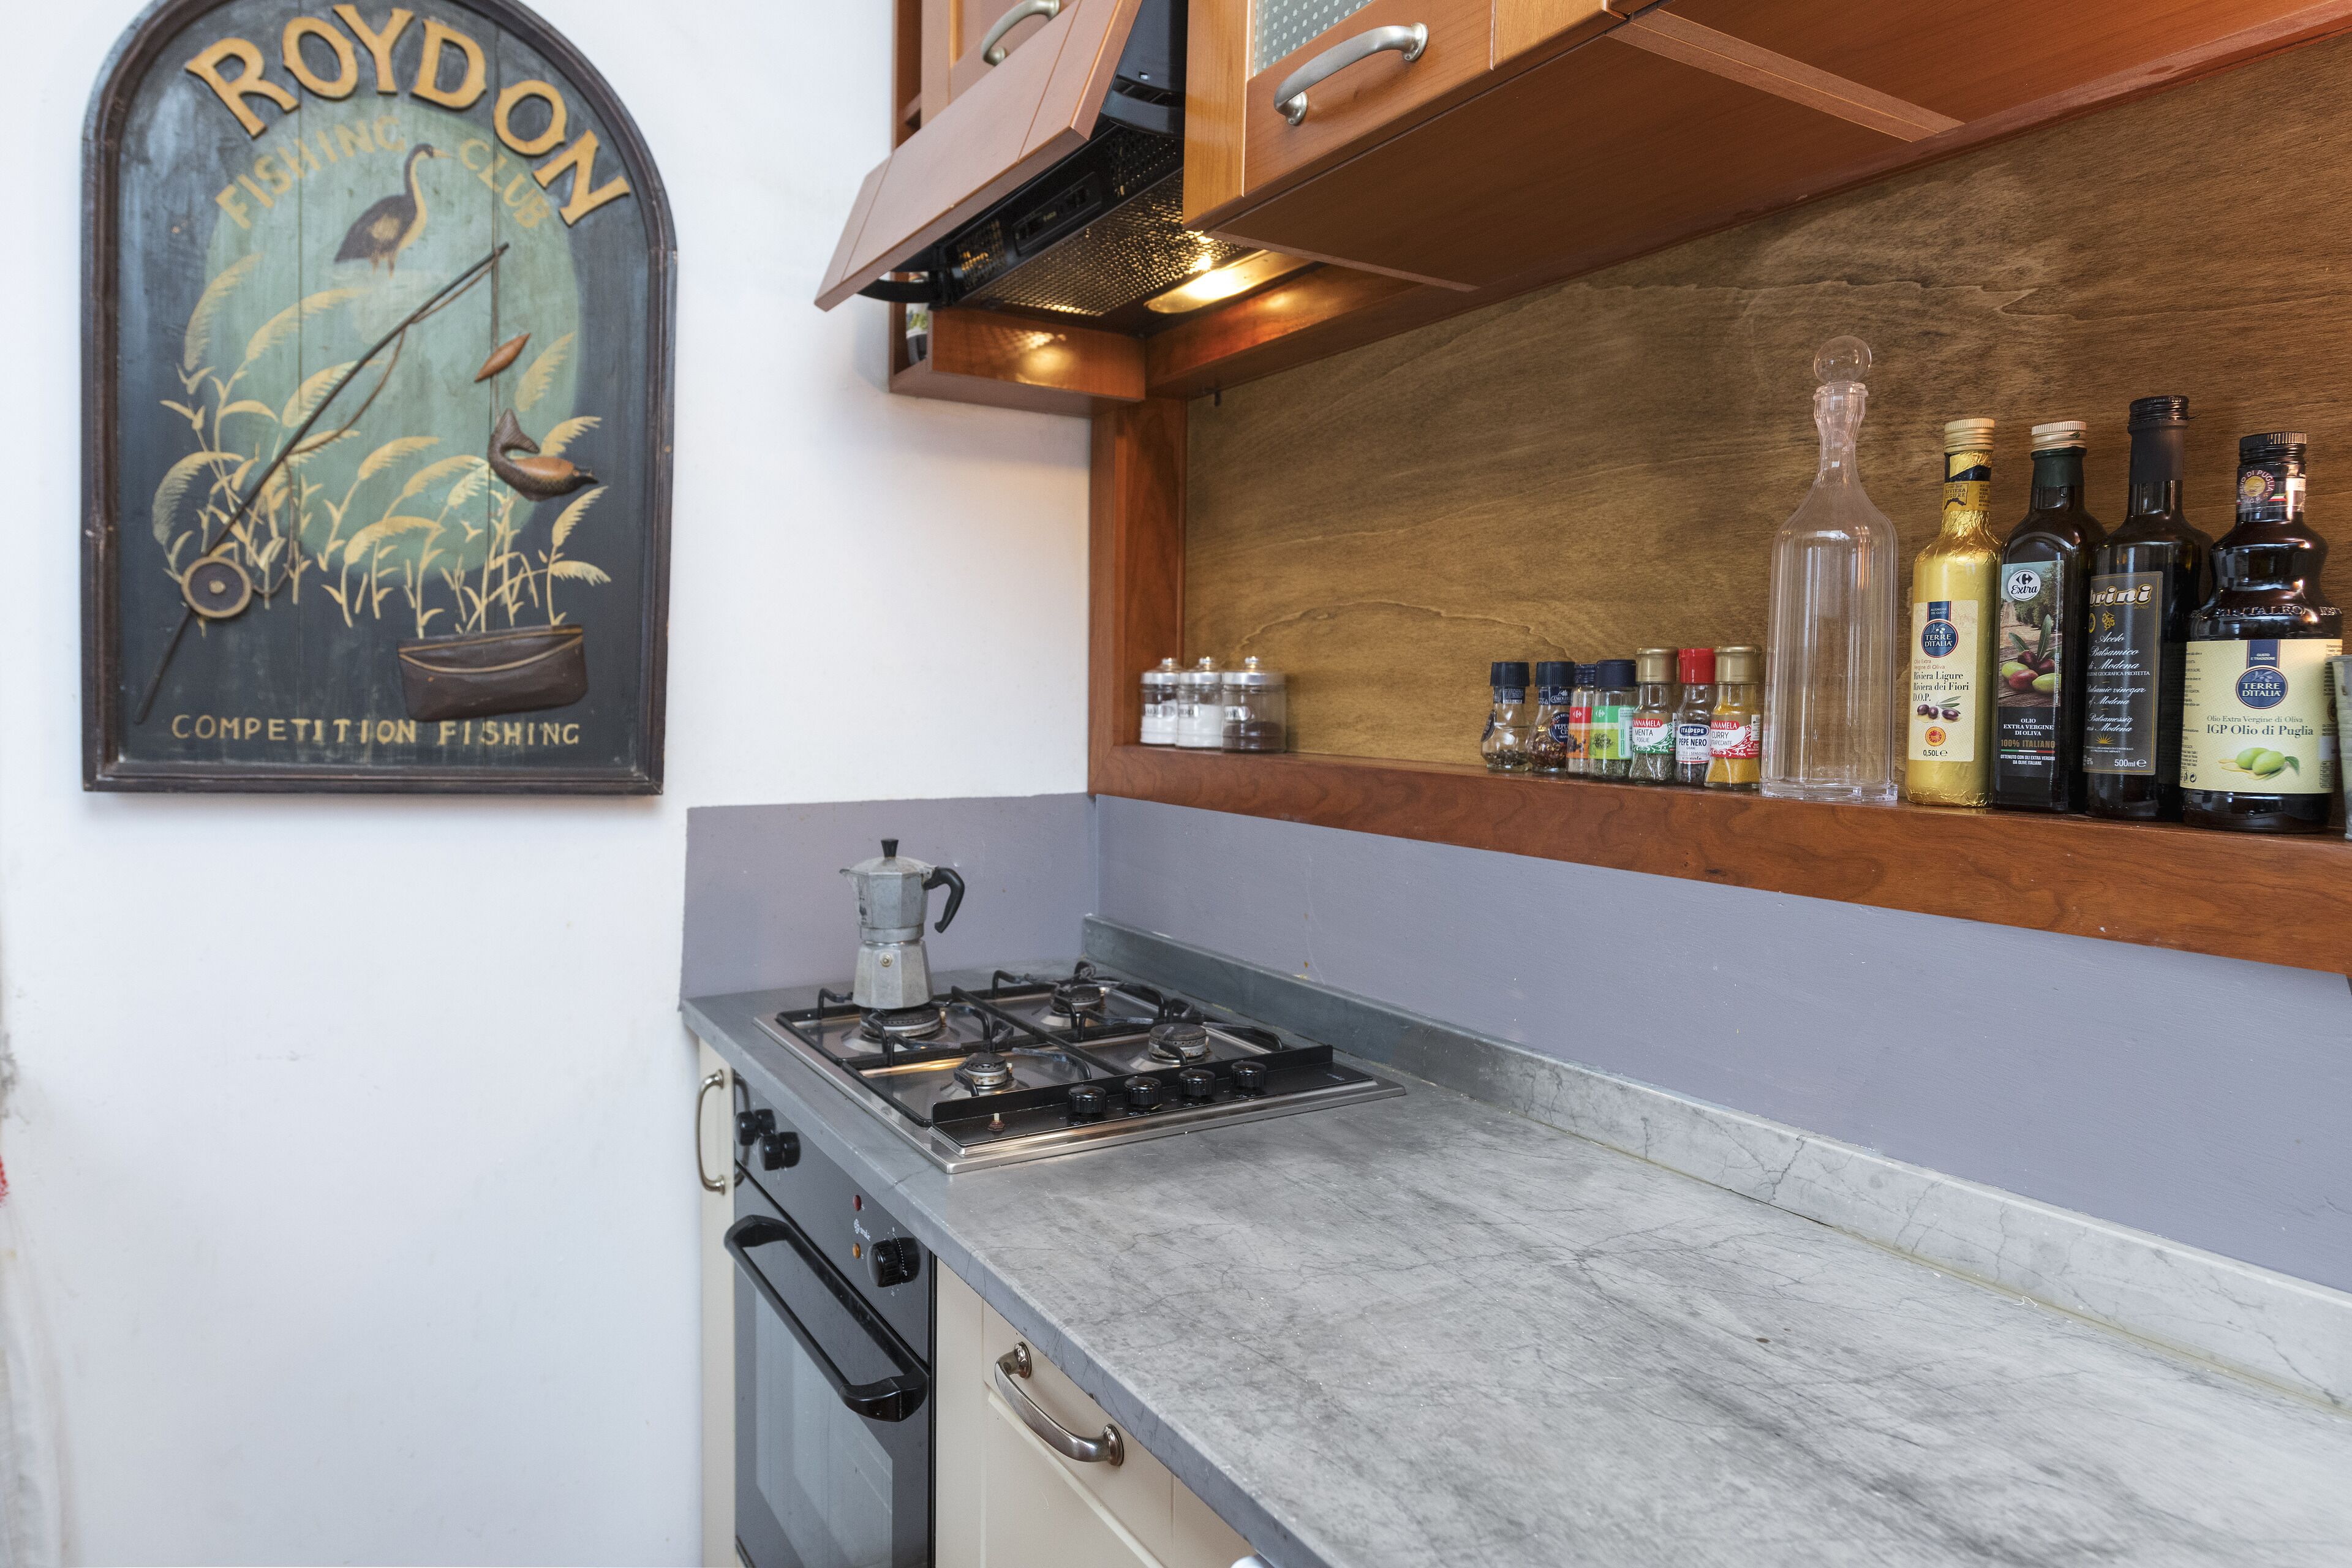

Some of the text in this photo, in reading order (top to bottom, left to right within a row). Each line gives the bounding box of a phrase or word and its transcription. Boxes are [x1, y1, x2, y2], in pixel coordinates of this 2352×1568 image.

[185, 3, 630, 227] ROYDON
[215, 115, 551, 230] FISHING CLUB
[2257, 470, 2275, 492] PUGLIA
[2011, 584, 2038, 595] Extra
[2095, 631, 2125, 643] Aceto
[2089, 645, 2140, 657] Balsamico
[2095, 658, 2141, 670] Modena
[1913, 671, 1964, 683] Riviera Ligure
[1913, 682, 1969, 691] Riviera dei Fiori
[1913, 693, 1931, 701] D.O.P.
[2094, 696, 2130, 705] Modena
[2243, 715, 2273, 724] Vergine
[171, 714, 580, 747] COMPETITION FISHING
[2094, 723, 2133, 732] Modena
[2207, 724, 2228, 734] IGP
[2231, 725, 2258, 735] Olio
[2261, 725, 2274, 735] di
[2278, 725, 2313, 739] Puglia
[1691, 738, 1707, 747] NERO
[2022, 739, 2056, 748] ITALIANO
